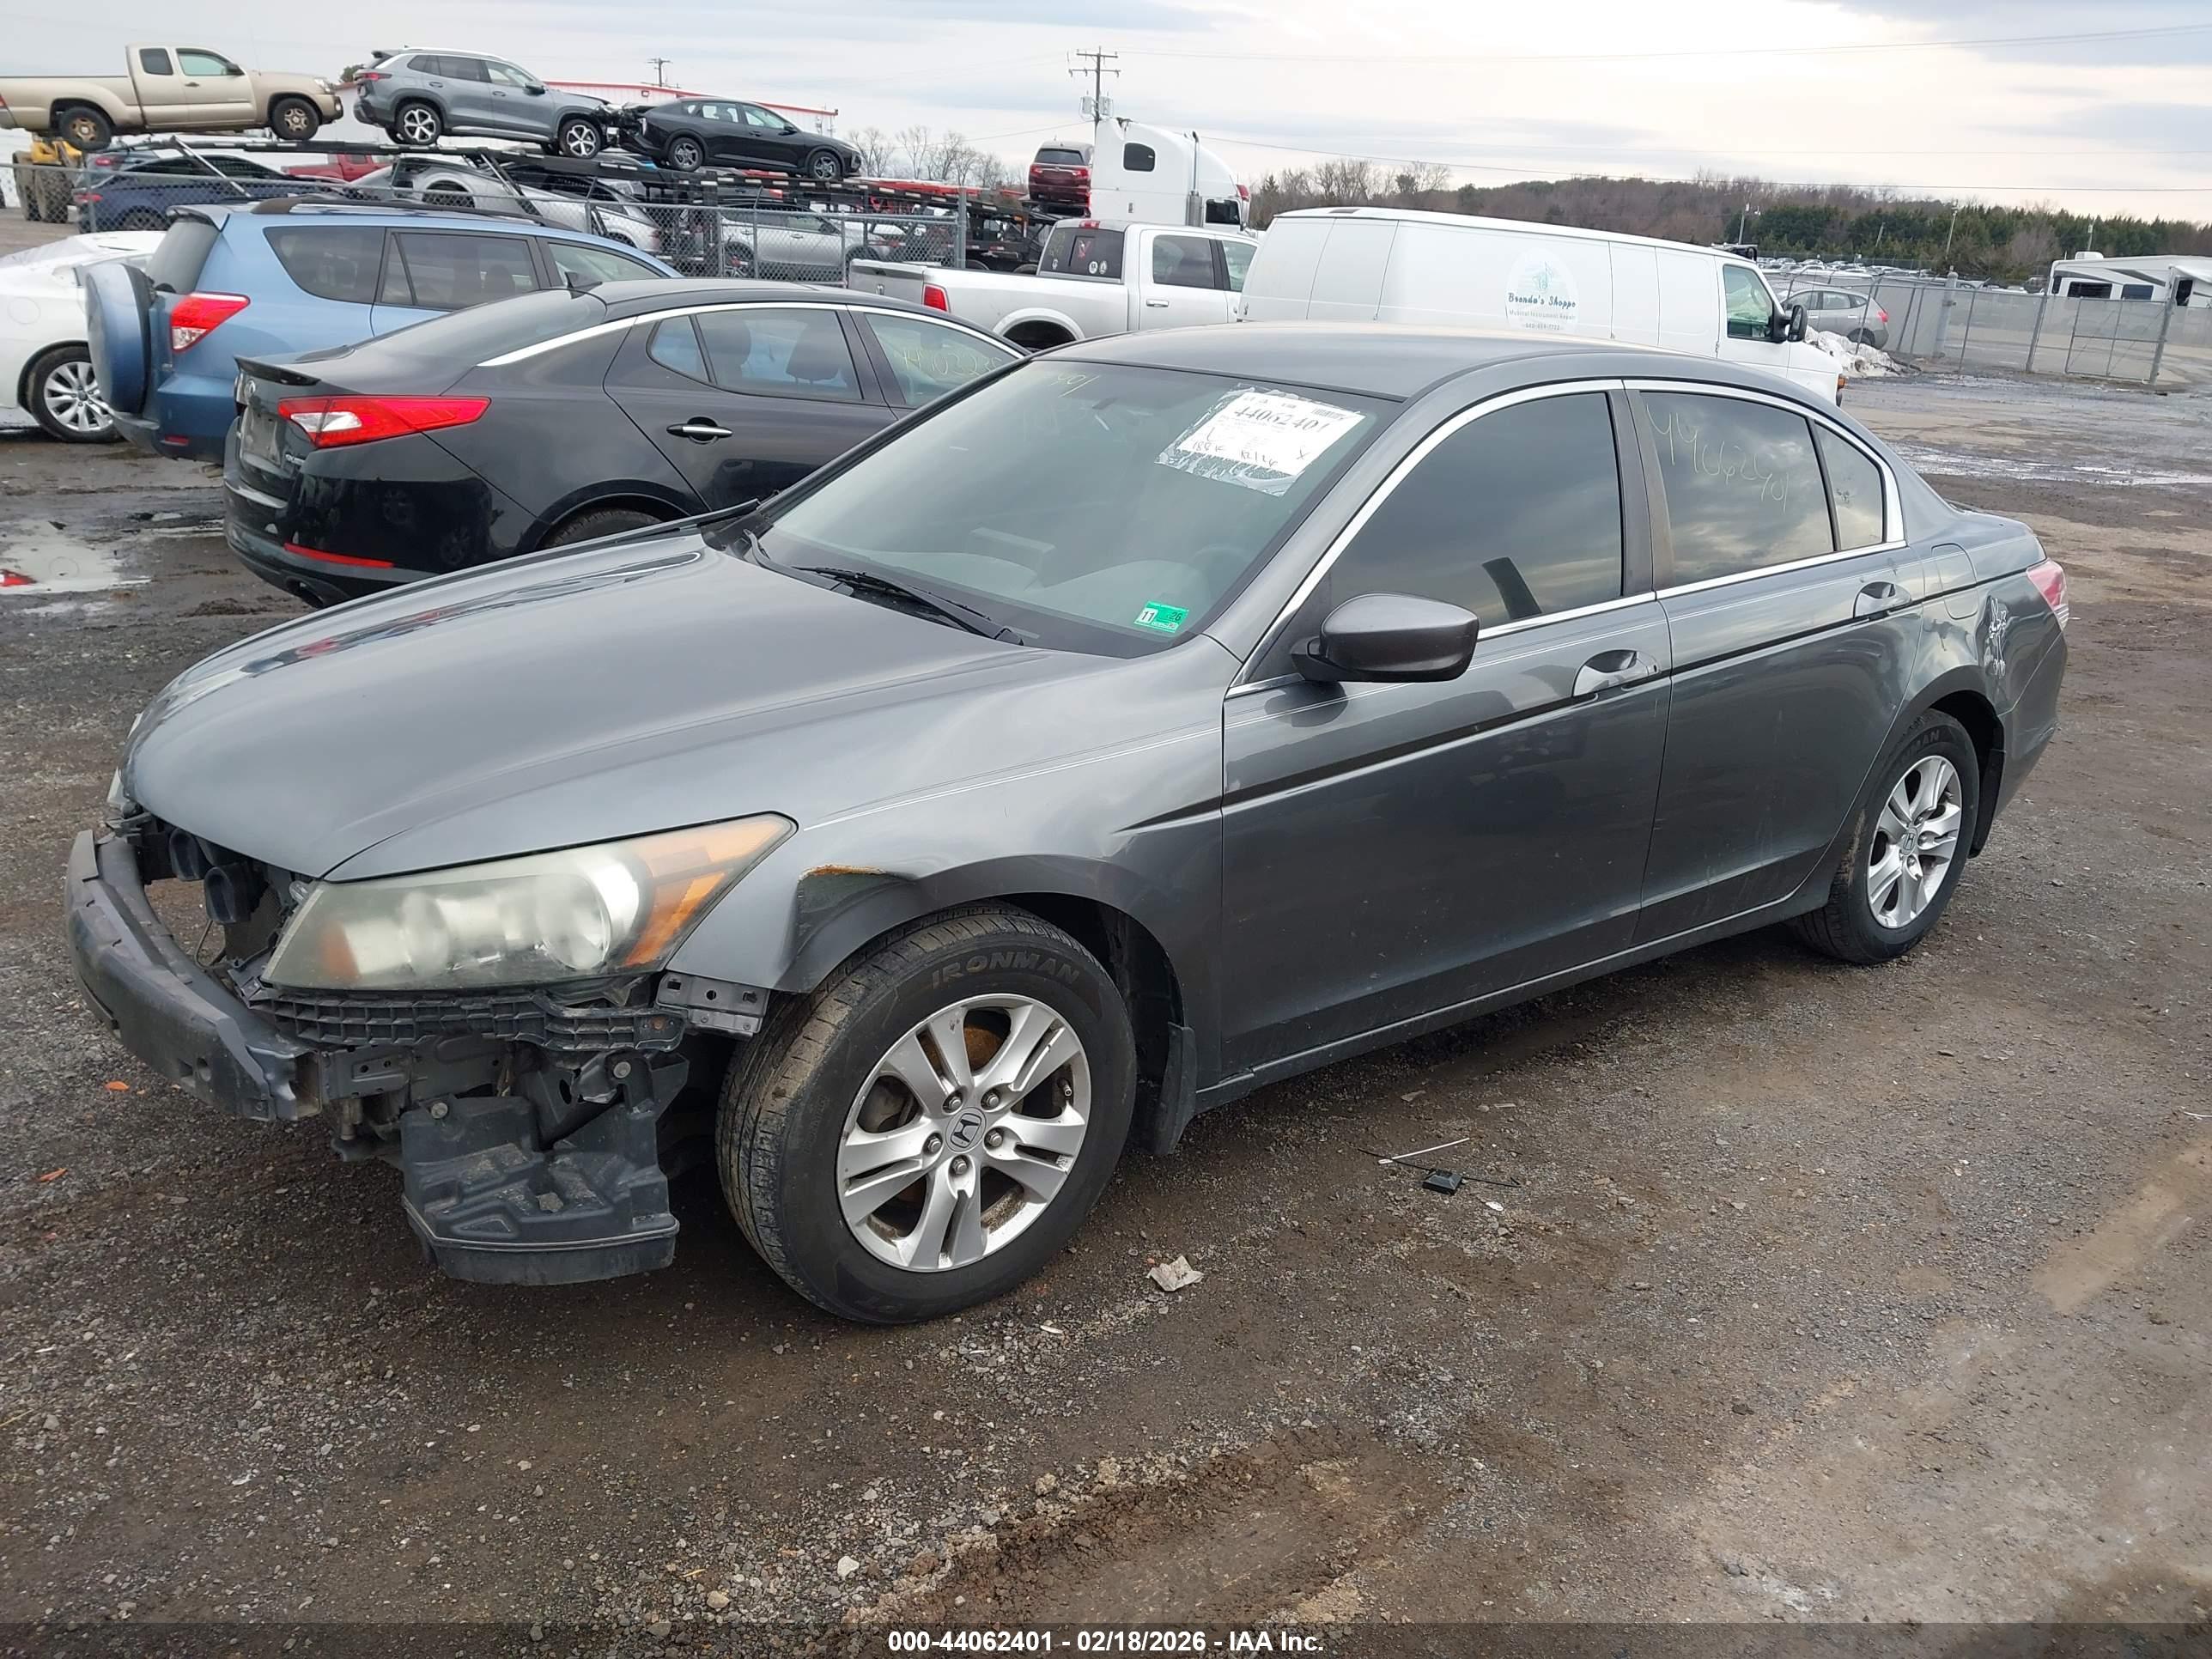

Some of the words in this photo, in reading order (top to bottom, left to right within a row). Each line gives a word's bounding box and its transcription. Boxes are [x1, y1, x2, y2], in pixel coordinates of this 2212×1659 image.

[1234, 405, 1330, 433] 44062401
[1141, 611, 1155, 622] 11
[931, 951, 1081, 989] IRONMAN
